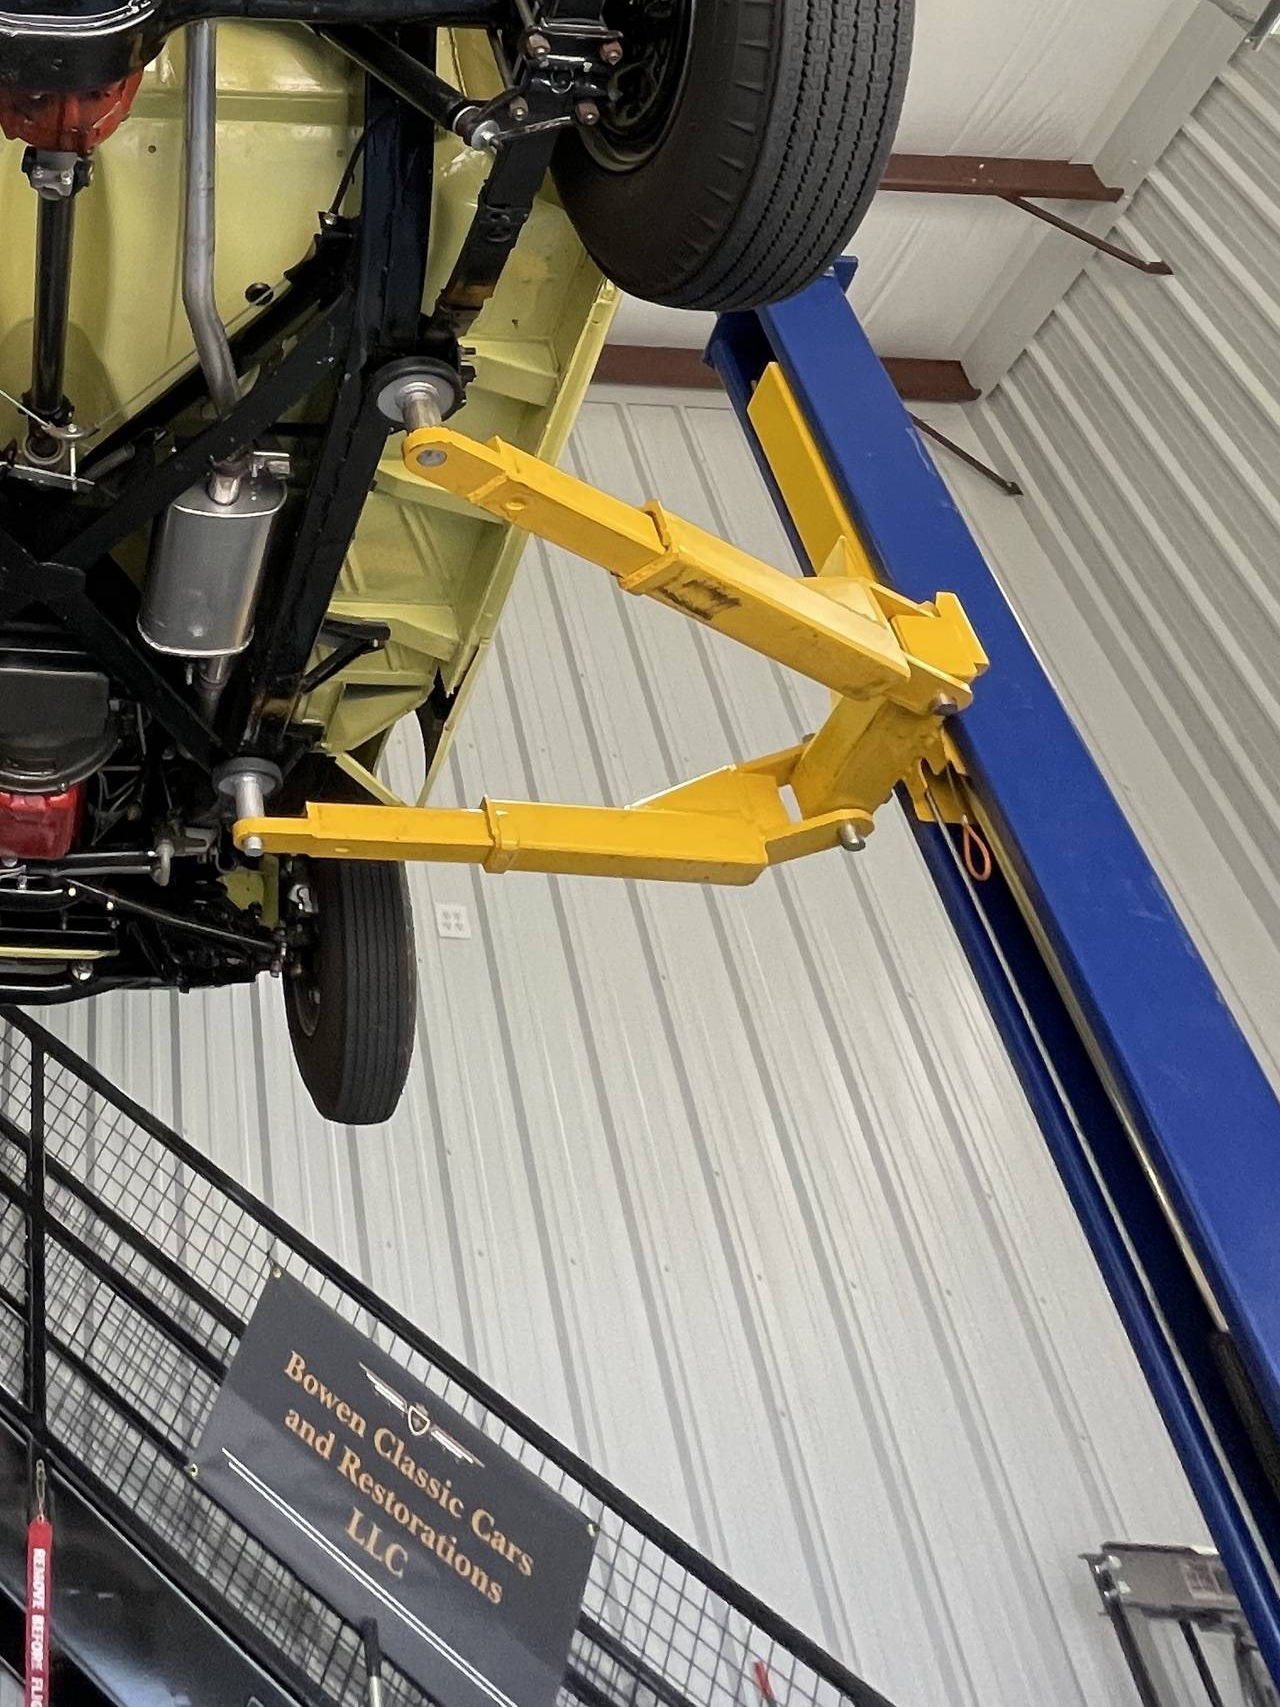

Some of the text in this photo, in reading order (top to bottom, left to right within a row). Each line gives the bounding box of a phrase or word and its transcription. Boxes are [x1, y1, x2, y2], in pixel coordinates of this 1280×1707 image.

[283, 1350, 535, 1577] Bowen Classic Cars
[284, 1408, 504, 1606] and Restorations
[345, 1507, 410, 1579] LLC
[32, 1547, 46, 1610] REMOVE
[31, 1614, 45, 1671] BEFORE
